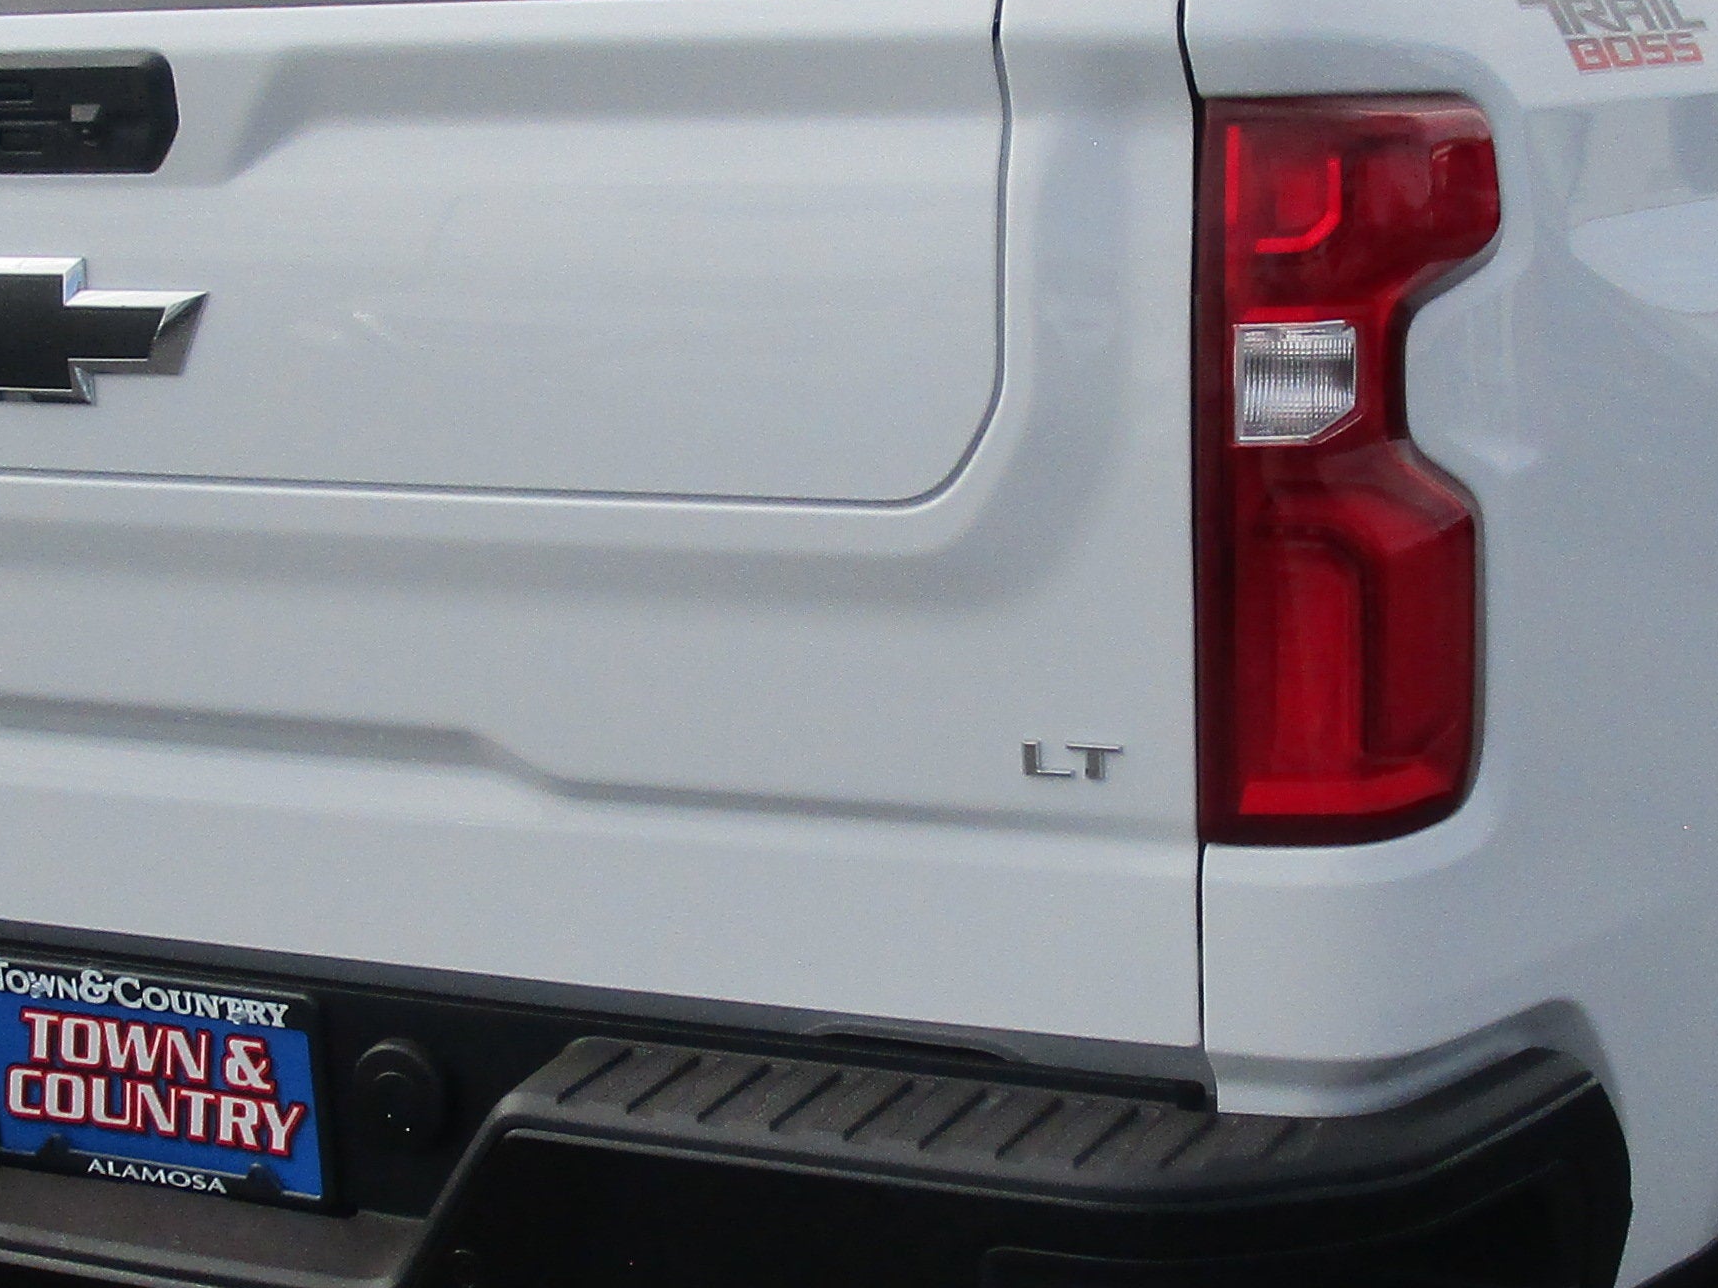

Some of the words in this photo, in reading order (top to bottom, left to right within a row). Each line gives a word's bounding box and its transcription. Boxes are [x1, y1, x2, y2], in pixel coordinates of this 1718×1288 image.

[1564, 32, 1705, 75] BOSS
[1021, 739, 1124, 781] LT
[20, 1007, 212, 1083] TOWN
[222, 1032, 277, 1094] &
[6, 1065, 305, 1155] COUNTRY
[87, 1157, 228, 1195] ALAMOSA
